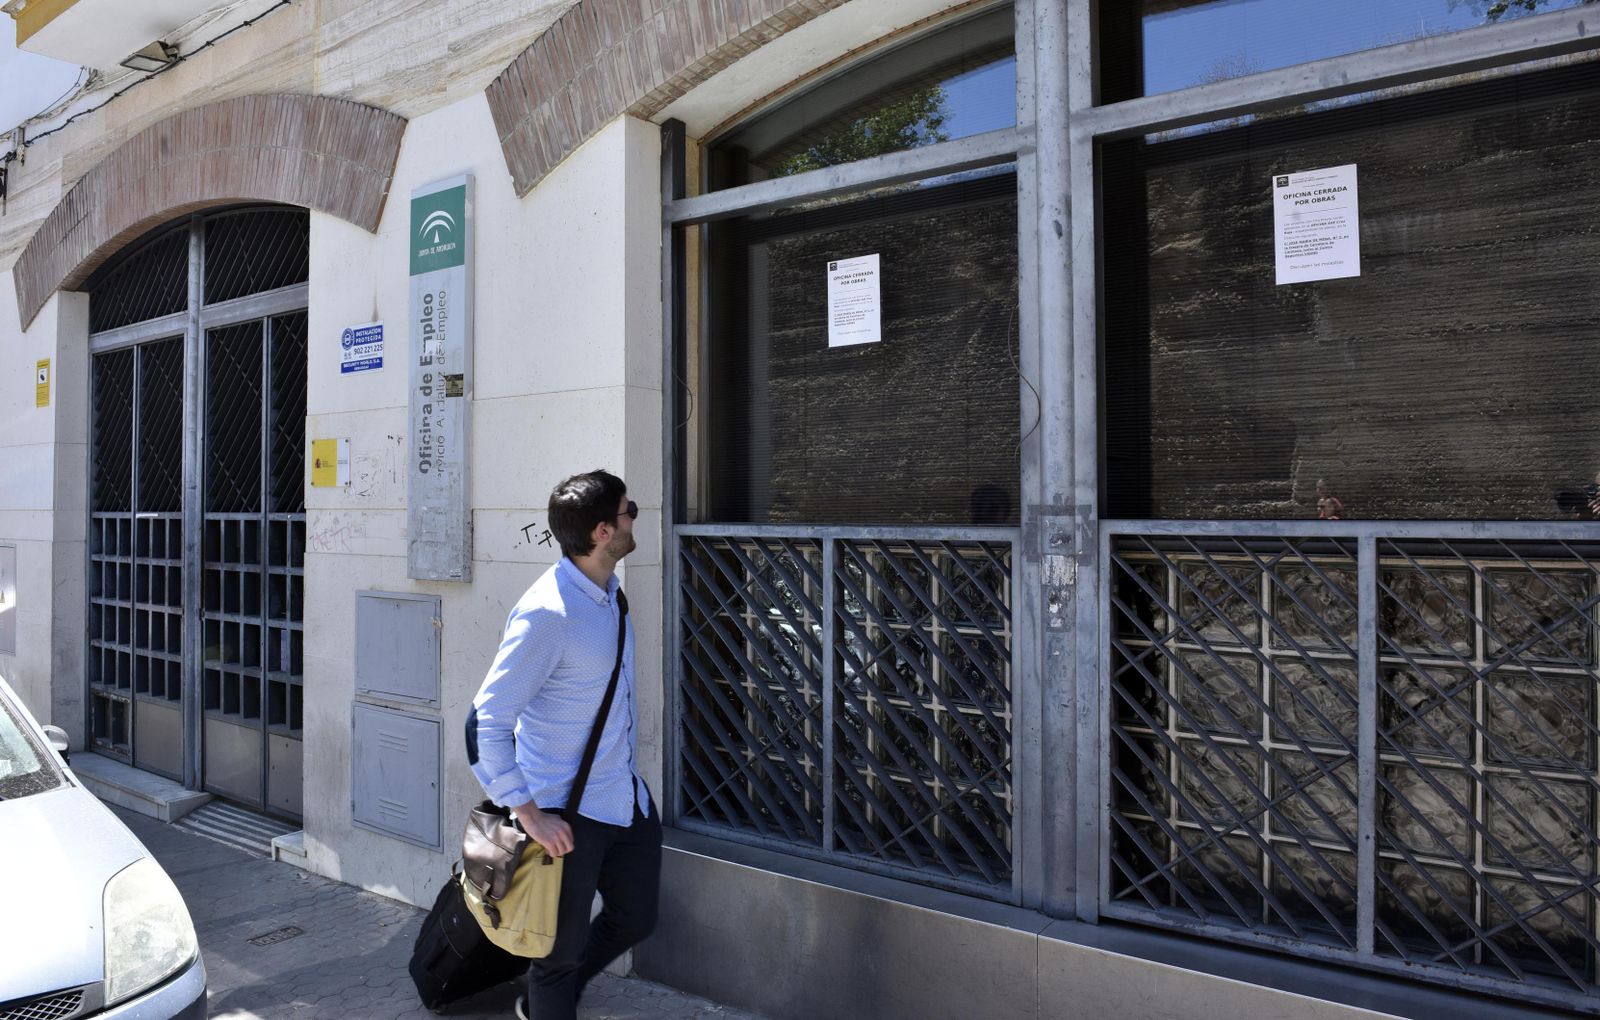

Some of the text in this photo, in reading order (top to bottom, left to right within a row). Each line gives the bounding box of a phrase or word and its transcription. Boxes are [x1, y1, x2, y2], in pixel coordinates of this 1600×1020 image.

[1283, 186, 1348, 200] OFICINA CERRADA
[1311, 195, 1336, 204] OBRAS
[436, 290, 448, 341] Empleo
[355, 334, 382, 343] PROTEGIDA
[354, 347, 364, 355] 902
[420, 373, 433, 397] de
